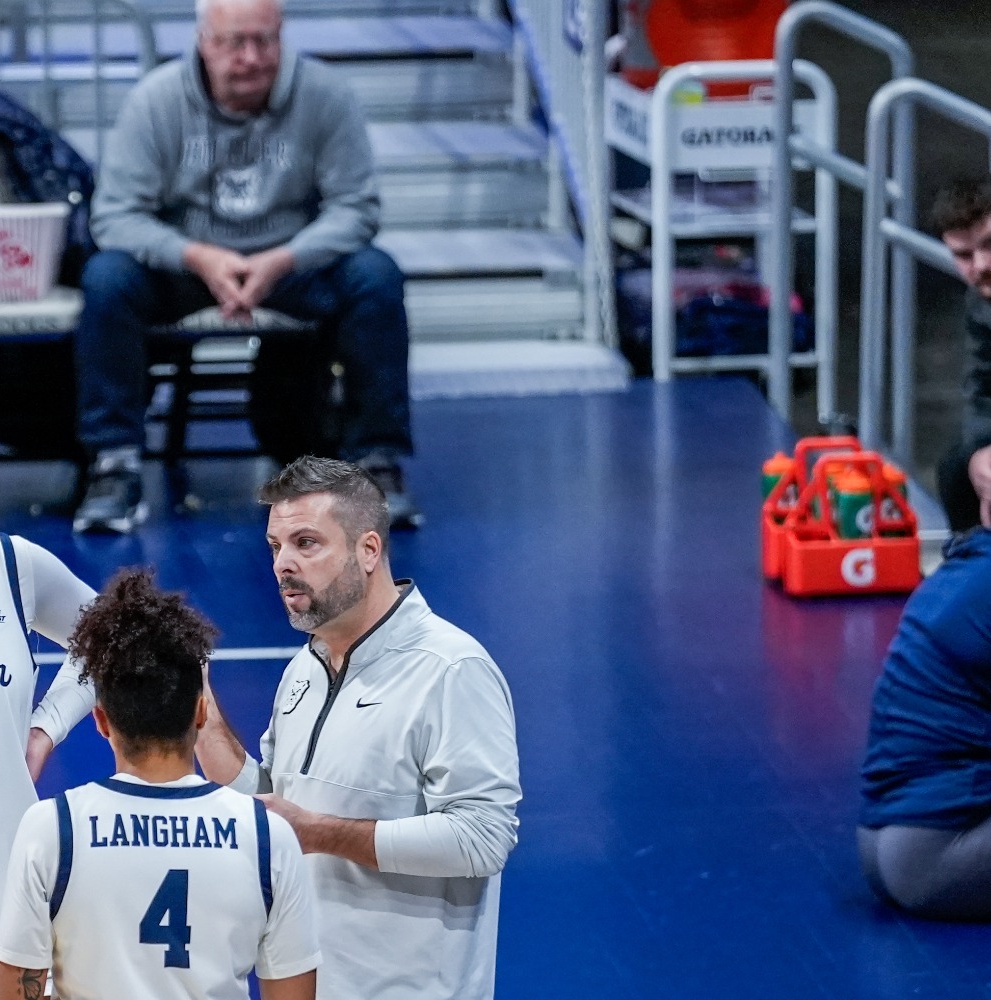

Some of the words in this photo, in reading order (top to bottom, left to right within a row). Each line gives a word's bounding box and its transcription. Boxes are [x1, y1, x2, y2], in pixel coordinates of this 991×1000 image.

[680, 125, 801, 145] GATORA
[841, 548, 876, 587] G
[89, 813, 239, 849] LANGHAM
[139, 869, 191, 968] 4
